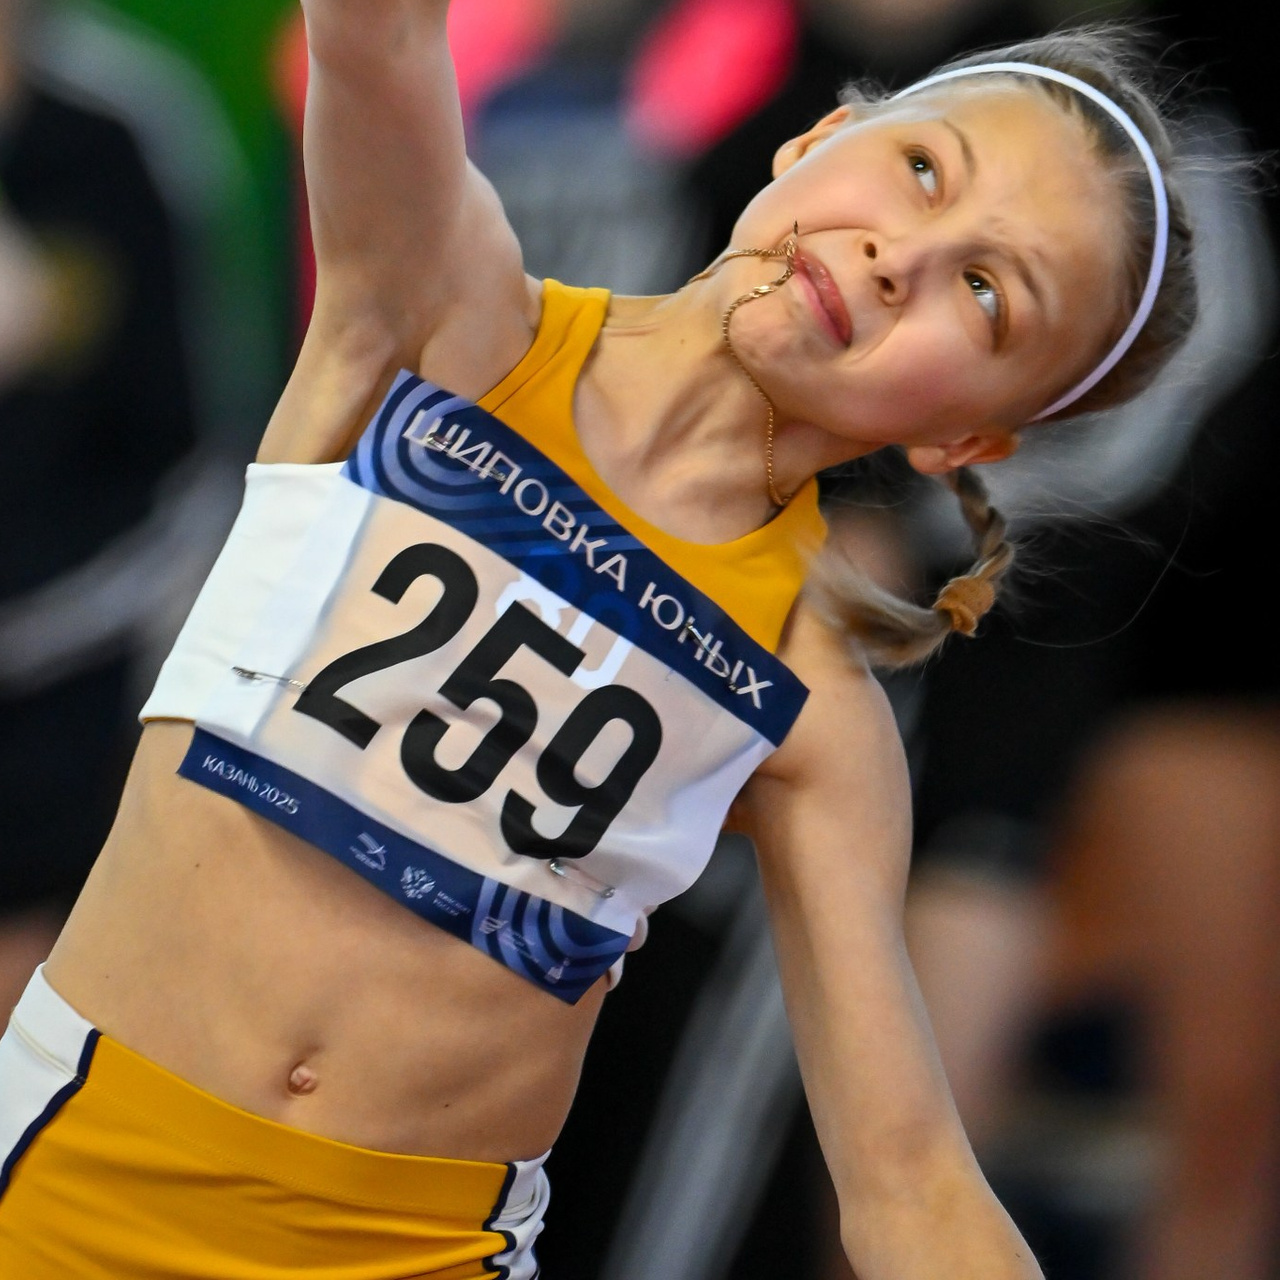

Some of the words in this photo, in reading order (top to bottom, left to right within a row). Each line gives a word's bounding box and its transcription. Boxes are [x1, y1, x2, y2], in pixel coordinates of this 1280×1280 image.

[292, 542, 663, 859] 259
[402, 408, 628, 592] ШИПОВКА
[638, 581, 774, 710] ЮНЫХ
[201, 754, 259, 793] КАЗАНЬ
[258, 782, 300, 815] 2025
